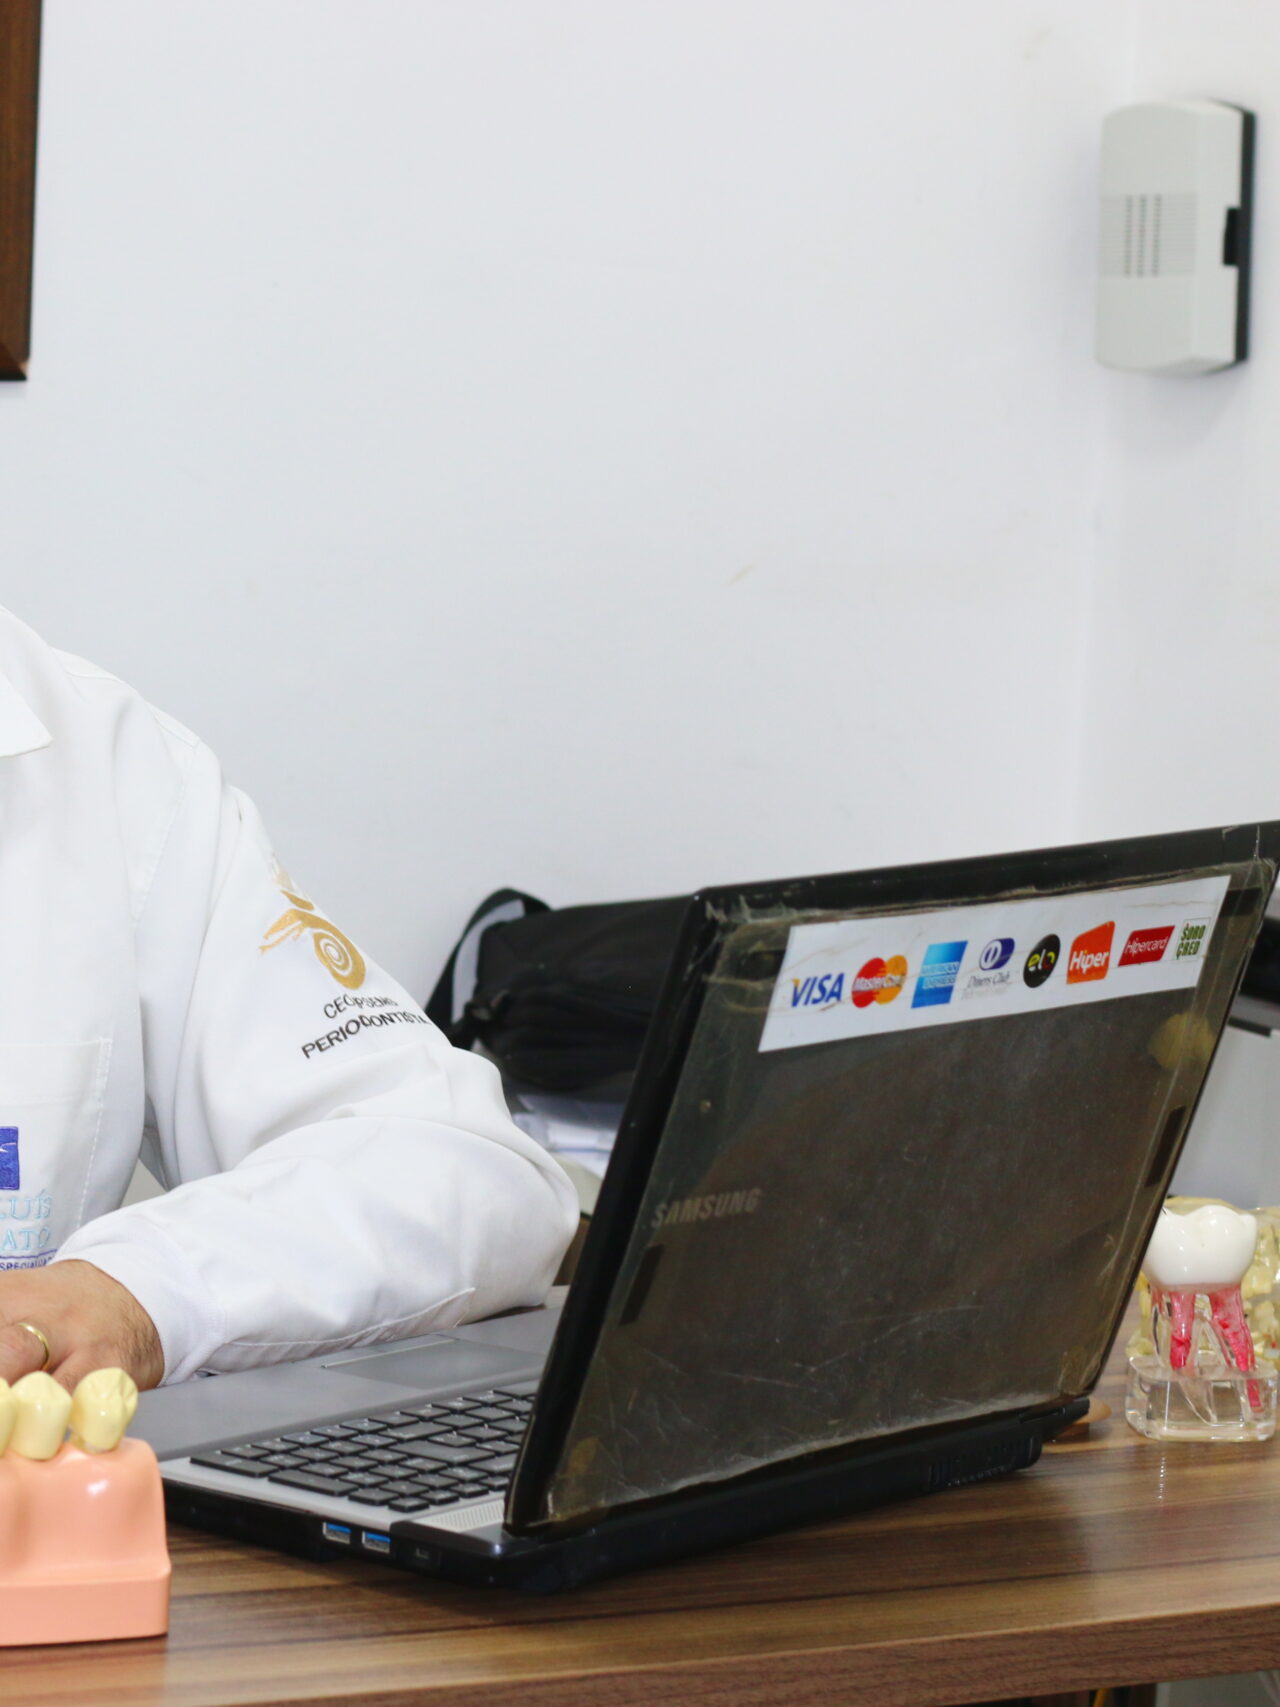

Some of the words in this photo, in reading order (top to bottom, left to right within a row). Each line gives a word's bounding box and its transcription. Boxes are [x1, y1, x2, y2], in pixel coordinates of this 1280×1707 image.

[1070, 950, 1110, 974] Hiper
[791, 972, 845, 1008] VISA
[650, 1188, 761, 1229] SAMSUNG
